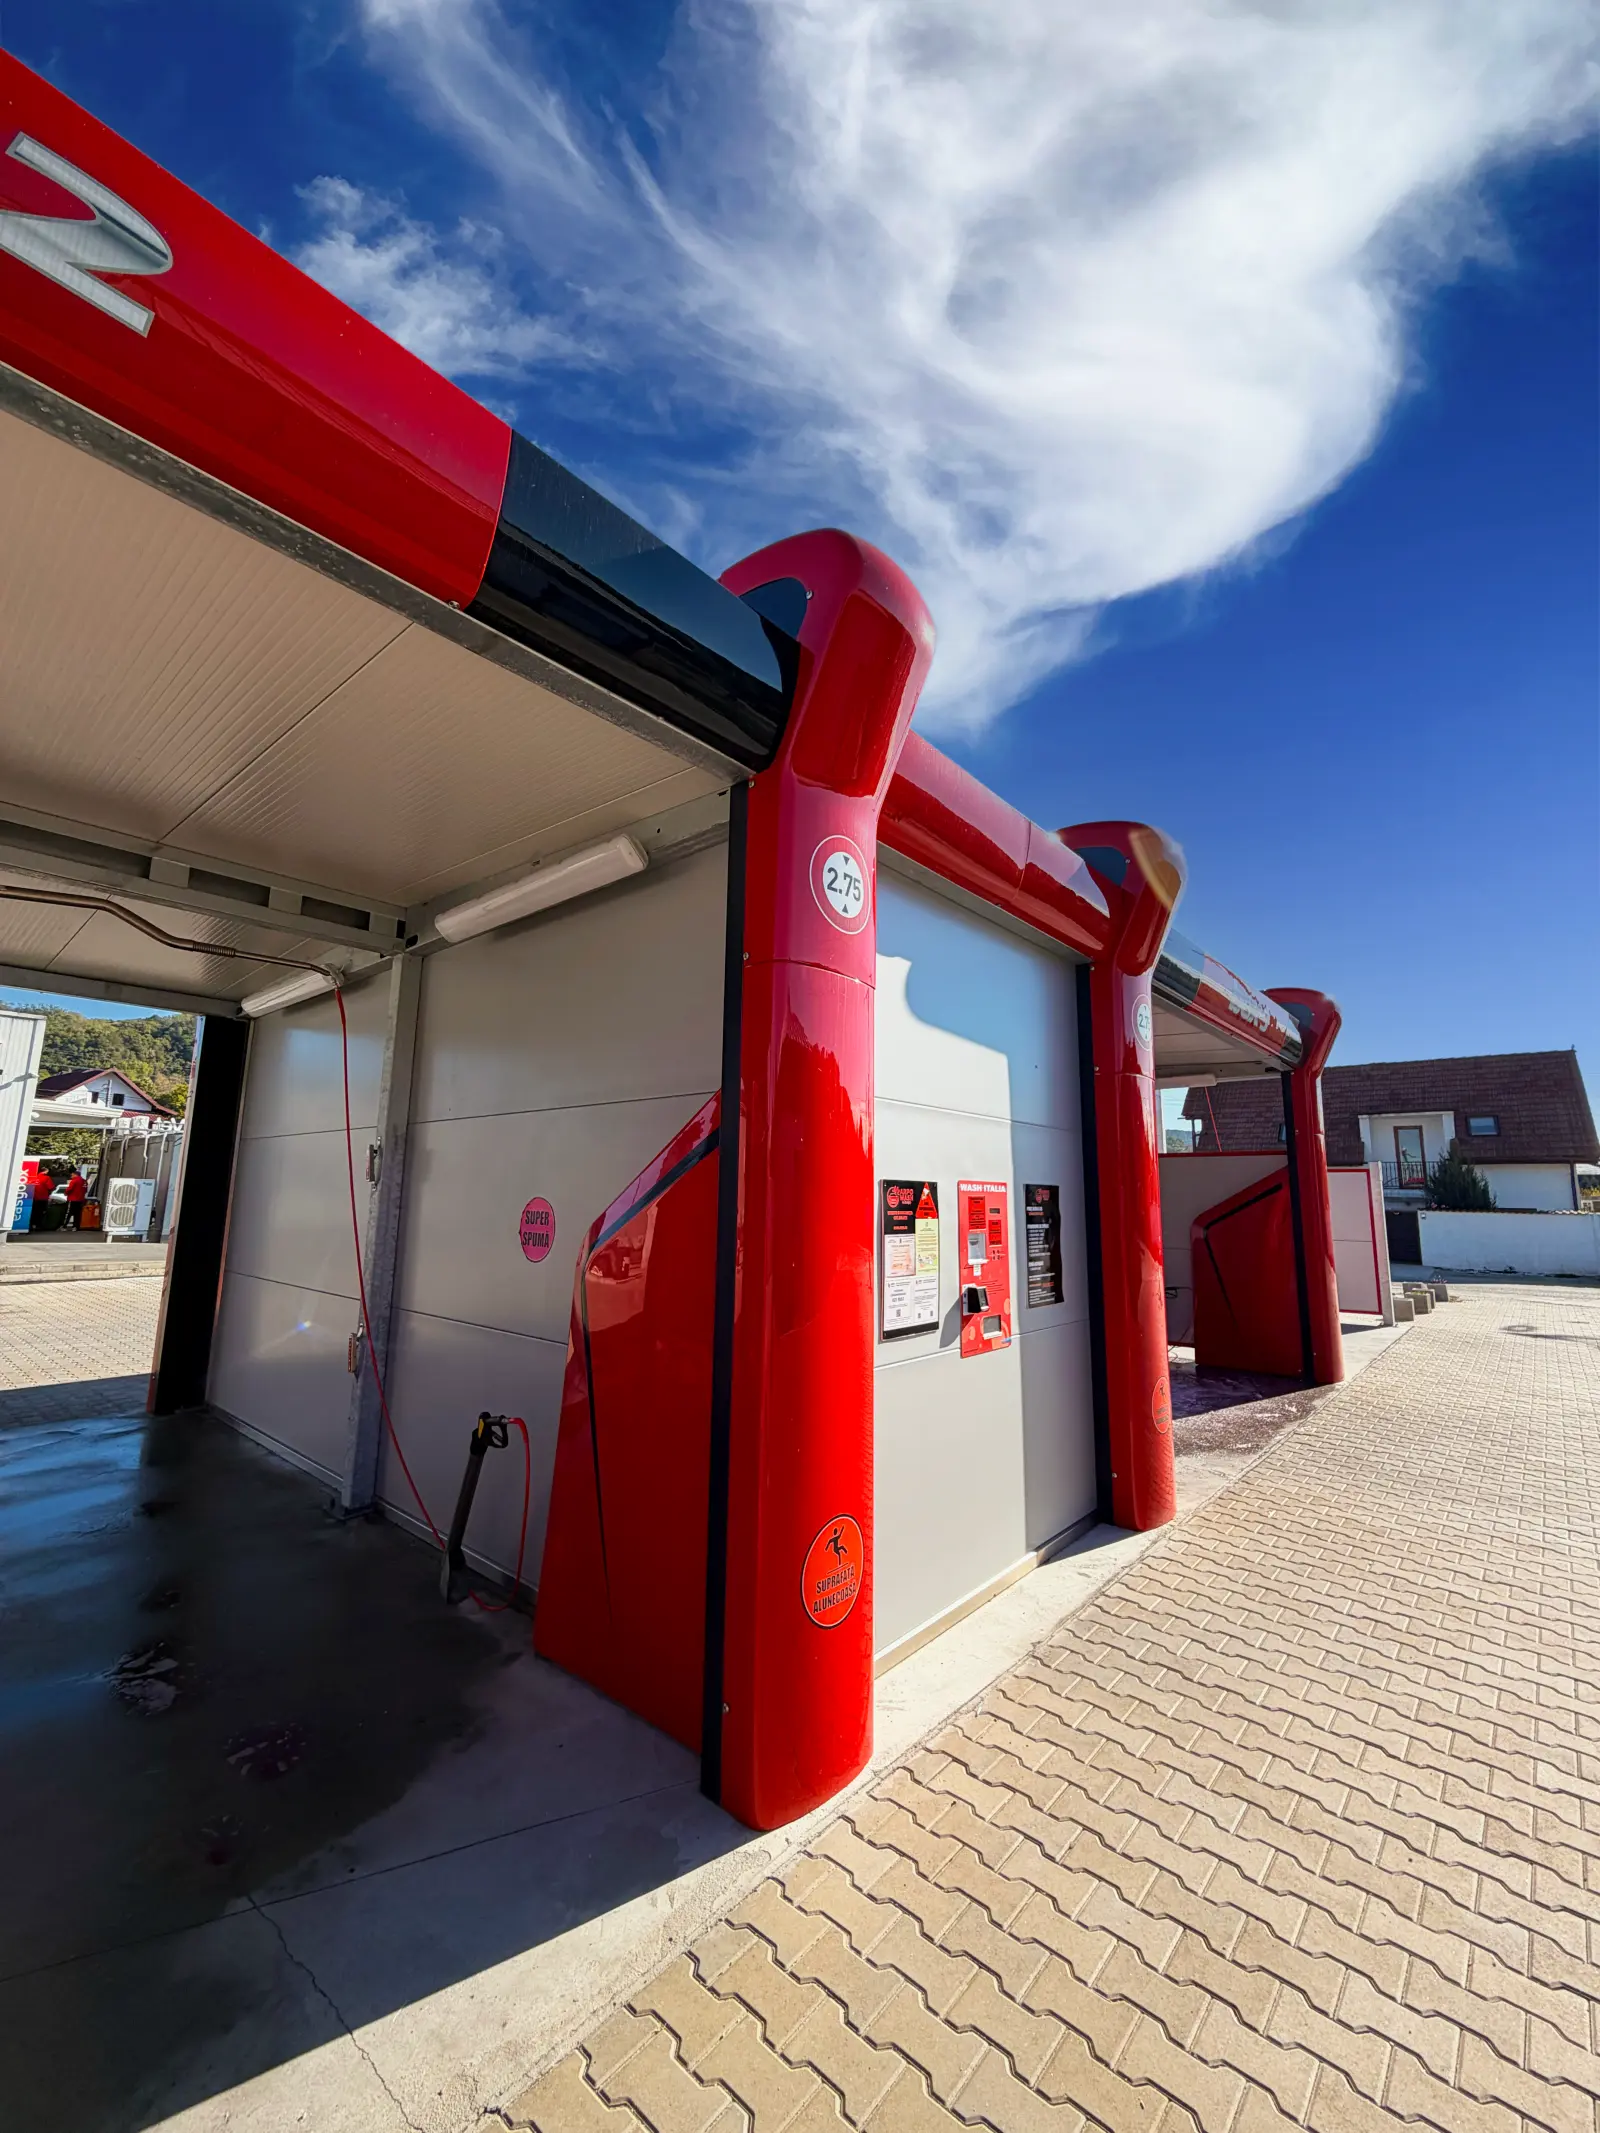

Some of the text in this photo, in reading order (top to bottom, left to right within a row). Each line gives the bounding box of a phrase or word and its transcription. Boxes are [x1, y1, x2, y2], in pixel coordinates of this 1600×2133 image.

[827, 867, 861, 902] 2.75
[14, 1169, 29, 1221] easybox
[960, 1184, 1007, 1193] WASH ITALIA
[525, 1210, 550, 1226] SUPER
